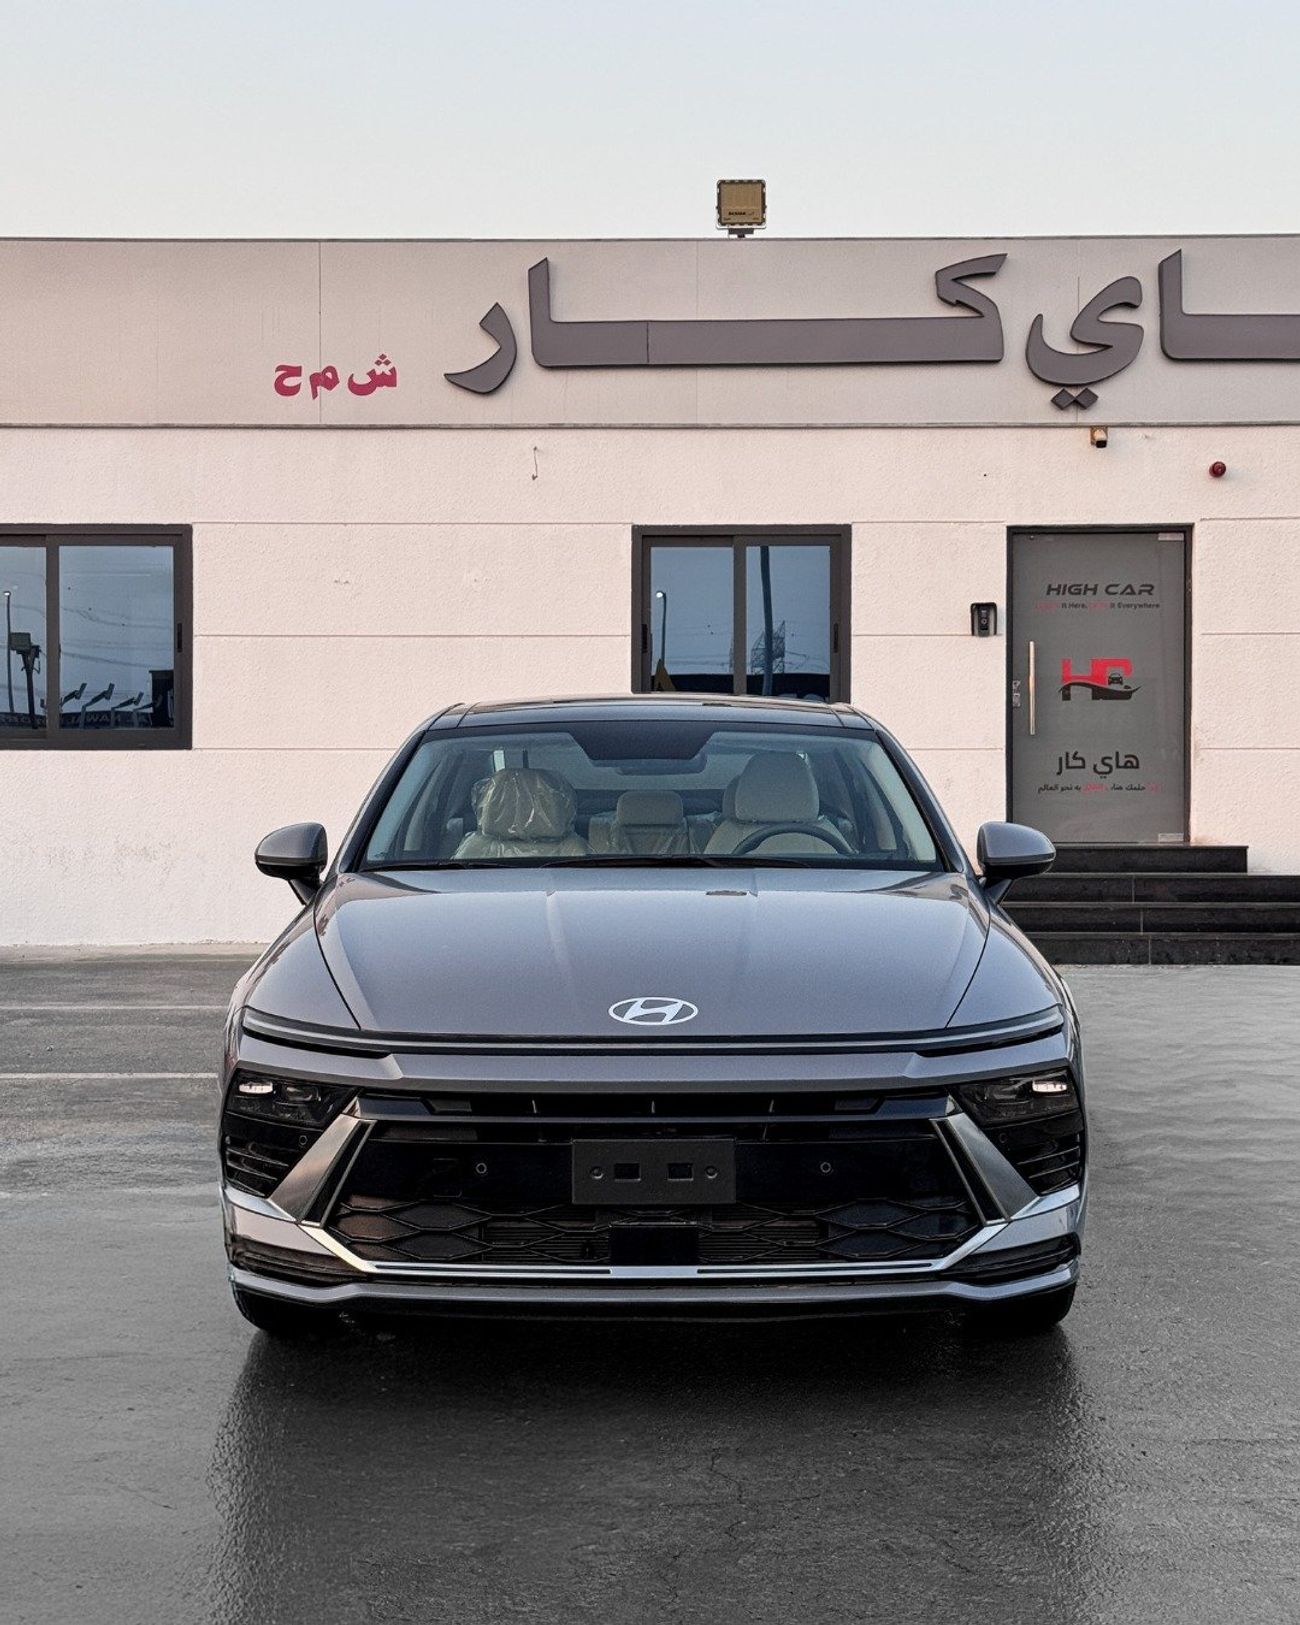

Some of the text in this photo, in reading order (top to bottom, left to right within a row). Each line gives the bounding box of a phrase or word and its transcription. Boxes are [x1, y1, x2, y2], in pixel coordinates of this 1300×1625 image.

[444, 252, 1008, 396] كار
[1046, 583, 1155, 596] HIGH CAR
[1118, 602, 1160, 610] Everywhere
[1056, 751, 1140, 779] هاي كار
